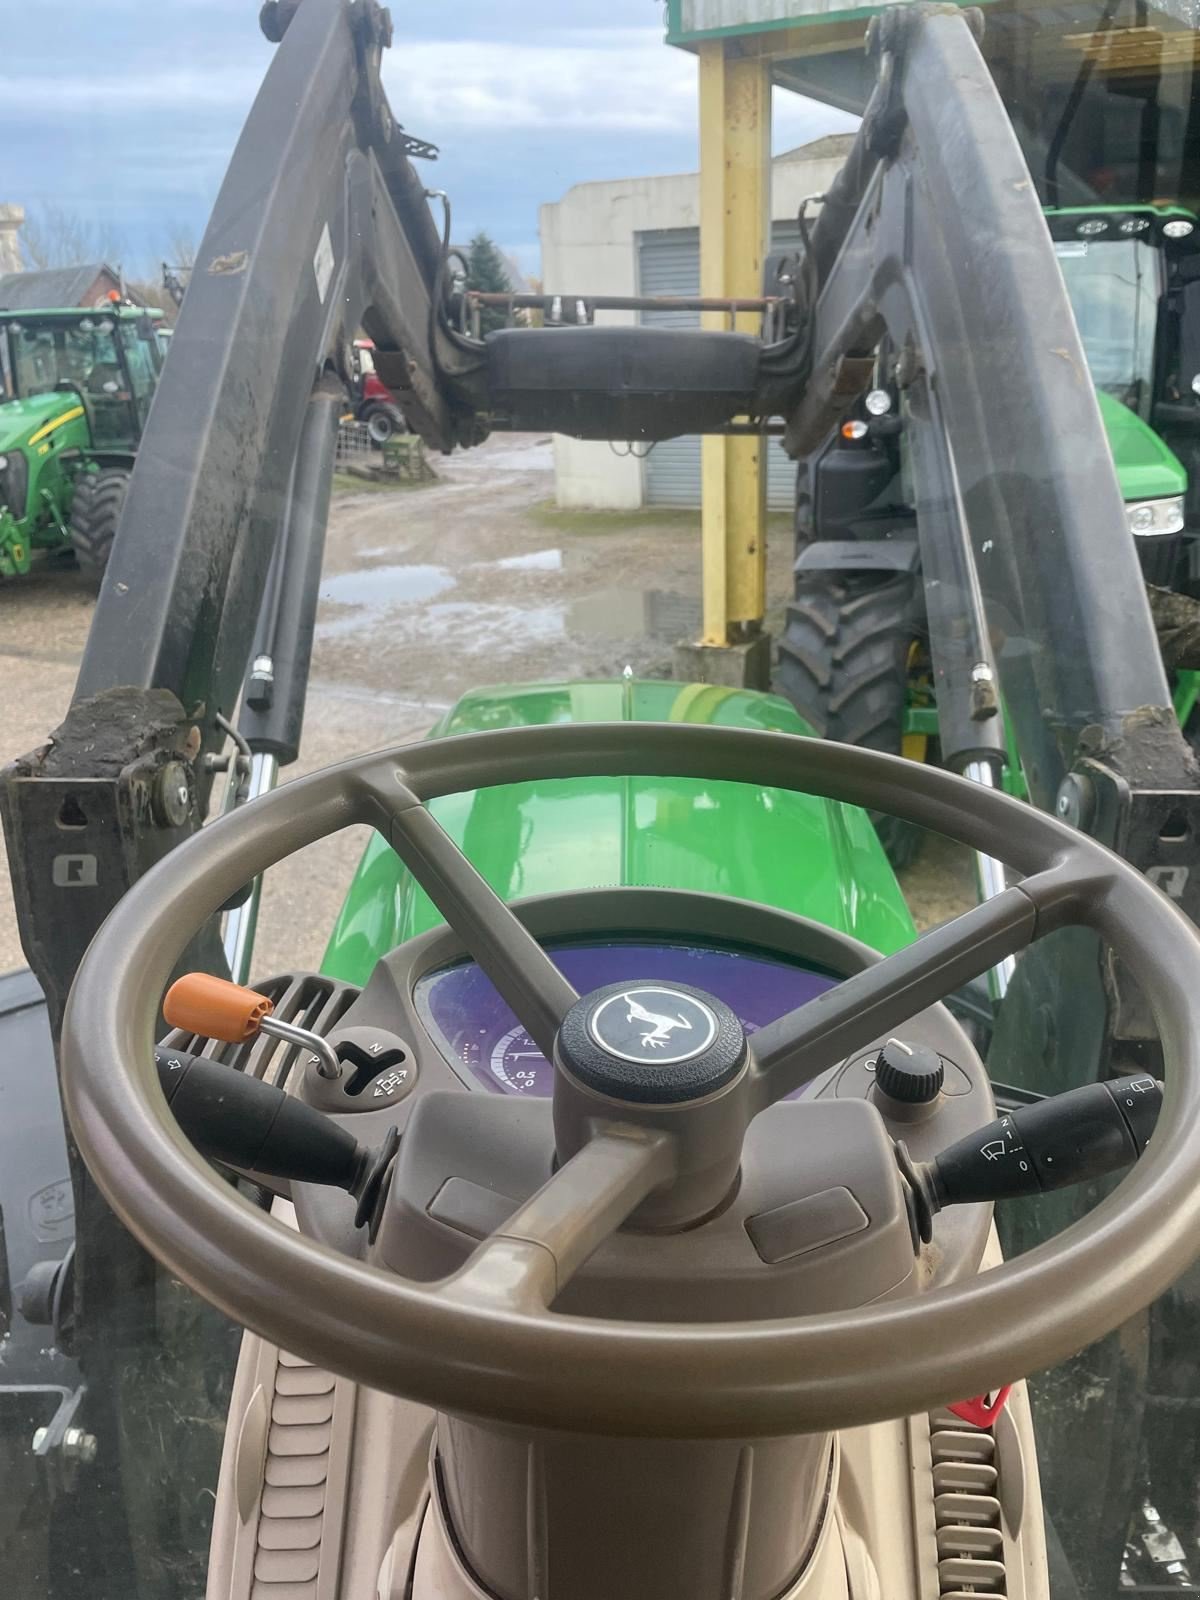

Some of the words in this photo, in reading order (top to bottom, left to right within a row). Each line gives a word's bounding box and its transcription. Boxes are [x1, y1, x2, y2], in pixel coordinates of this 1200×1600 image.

[369, 1042, 383, 1053] N
[307, 1055, 320, 1064] P
[516, 1071, 537, 1079] 0.5
[524, 1079, 535, 1087] 0
[1001, 1118, 1009, 1127] 2
